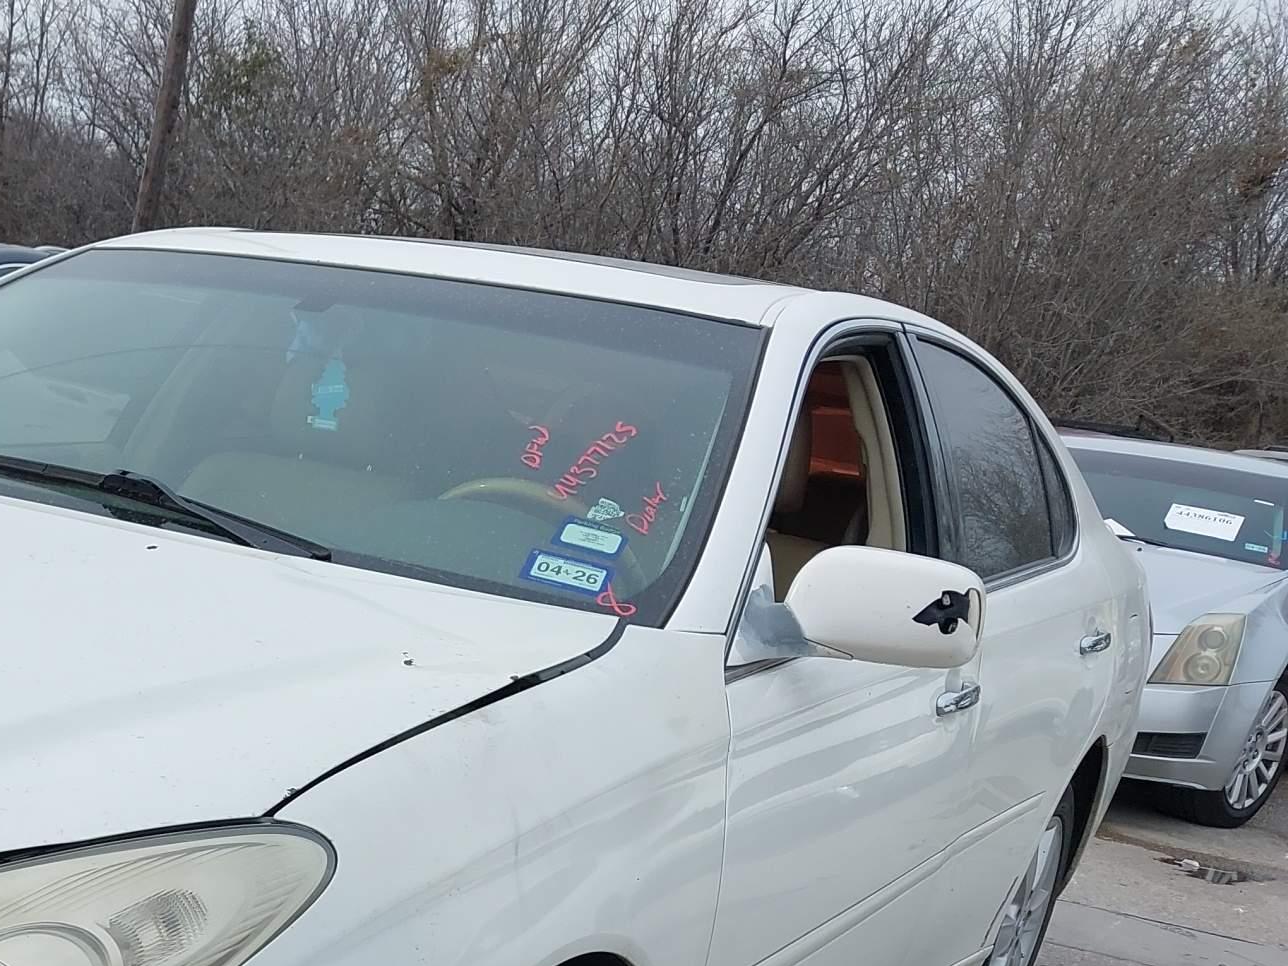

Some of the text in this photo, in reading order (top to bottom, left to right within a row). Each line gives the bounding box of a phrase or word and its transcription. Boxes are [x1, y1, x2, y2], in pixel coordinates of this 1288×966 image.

[520, 425, 550, 470] DFW
[547, 421, 638, 500] 44377125
[536, 561, 562, 576] 04
[572, 570, 600, 585] 26
